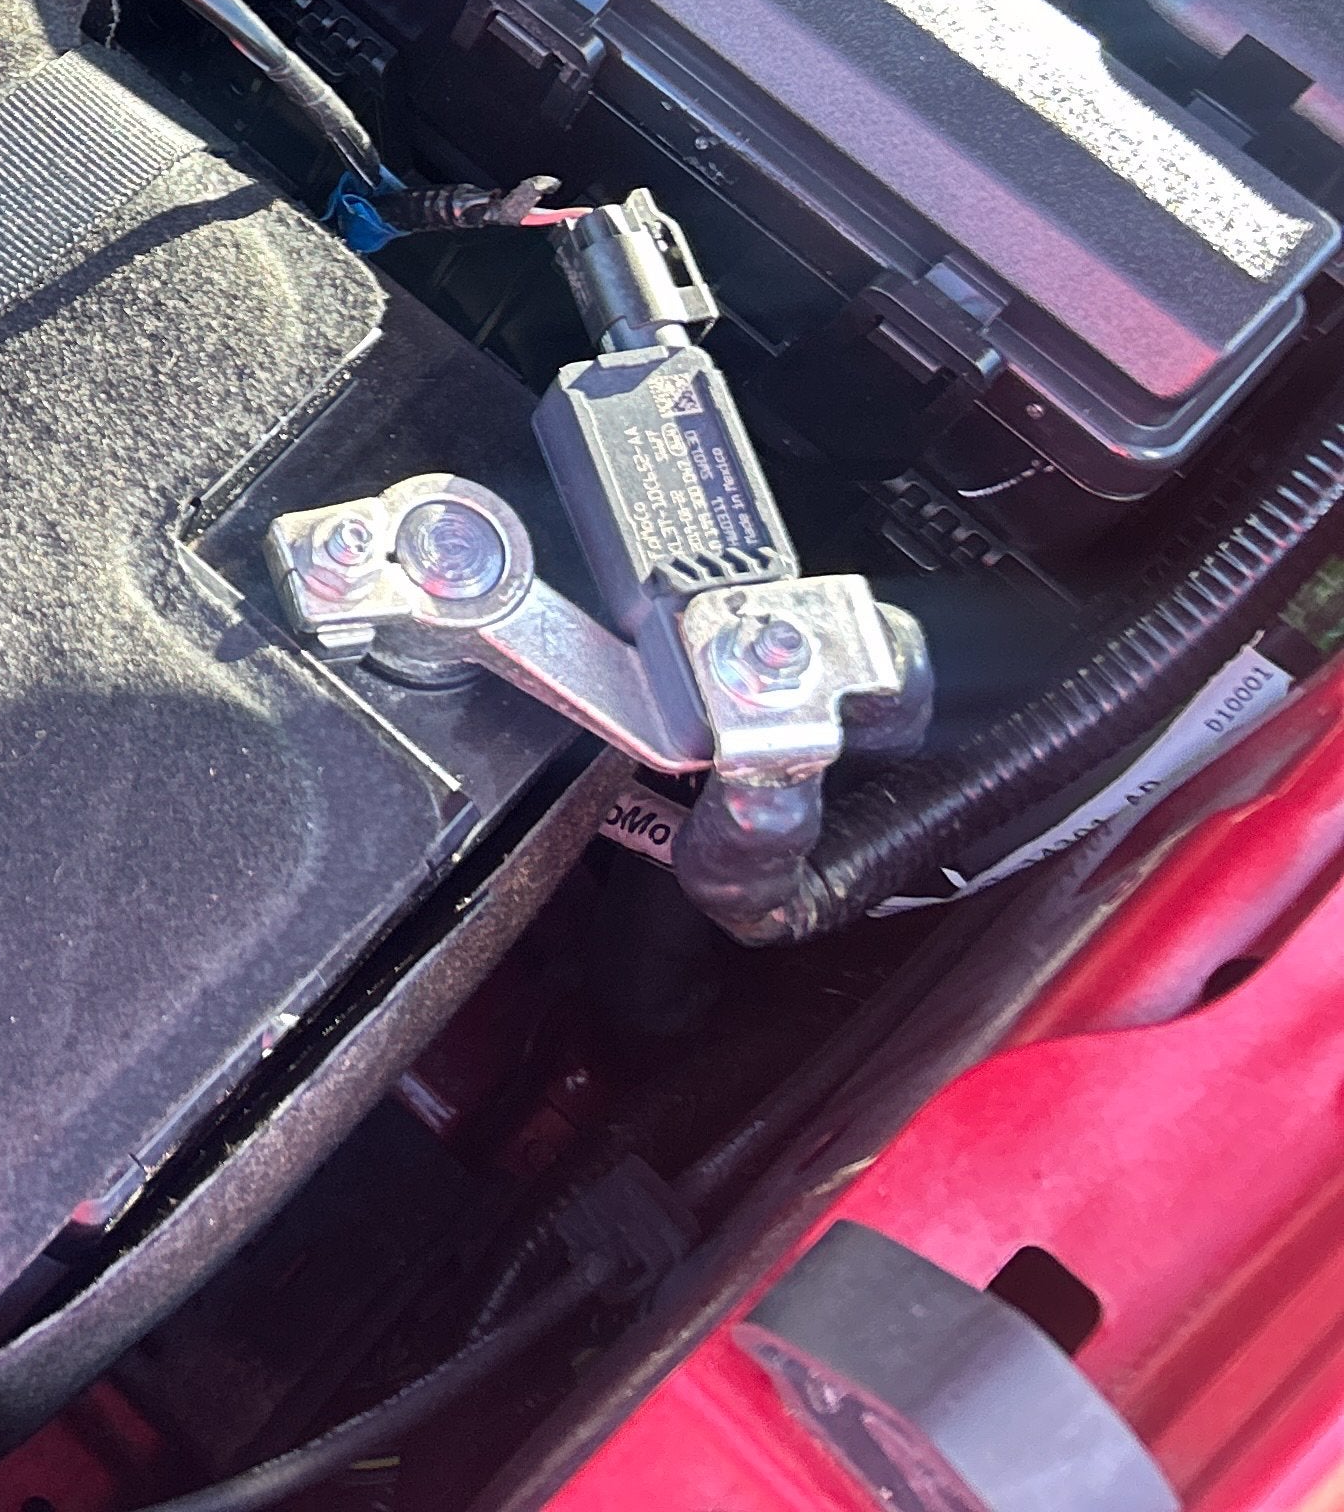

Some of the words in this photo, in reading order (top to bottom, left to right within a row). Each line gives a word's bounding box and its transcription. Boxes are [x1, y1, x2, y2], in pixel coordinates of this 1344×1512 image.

[709, 446, 736, 492] Mexico
[727, 493, 744, 509] in
[629, 500, 667, 562] FoMoCo
[734, 511, 757, 544] Made
[1202, 665, 1273, 731] D10001
